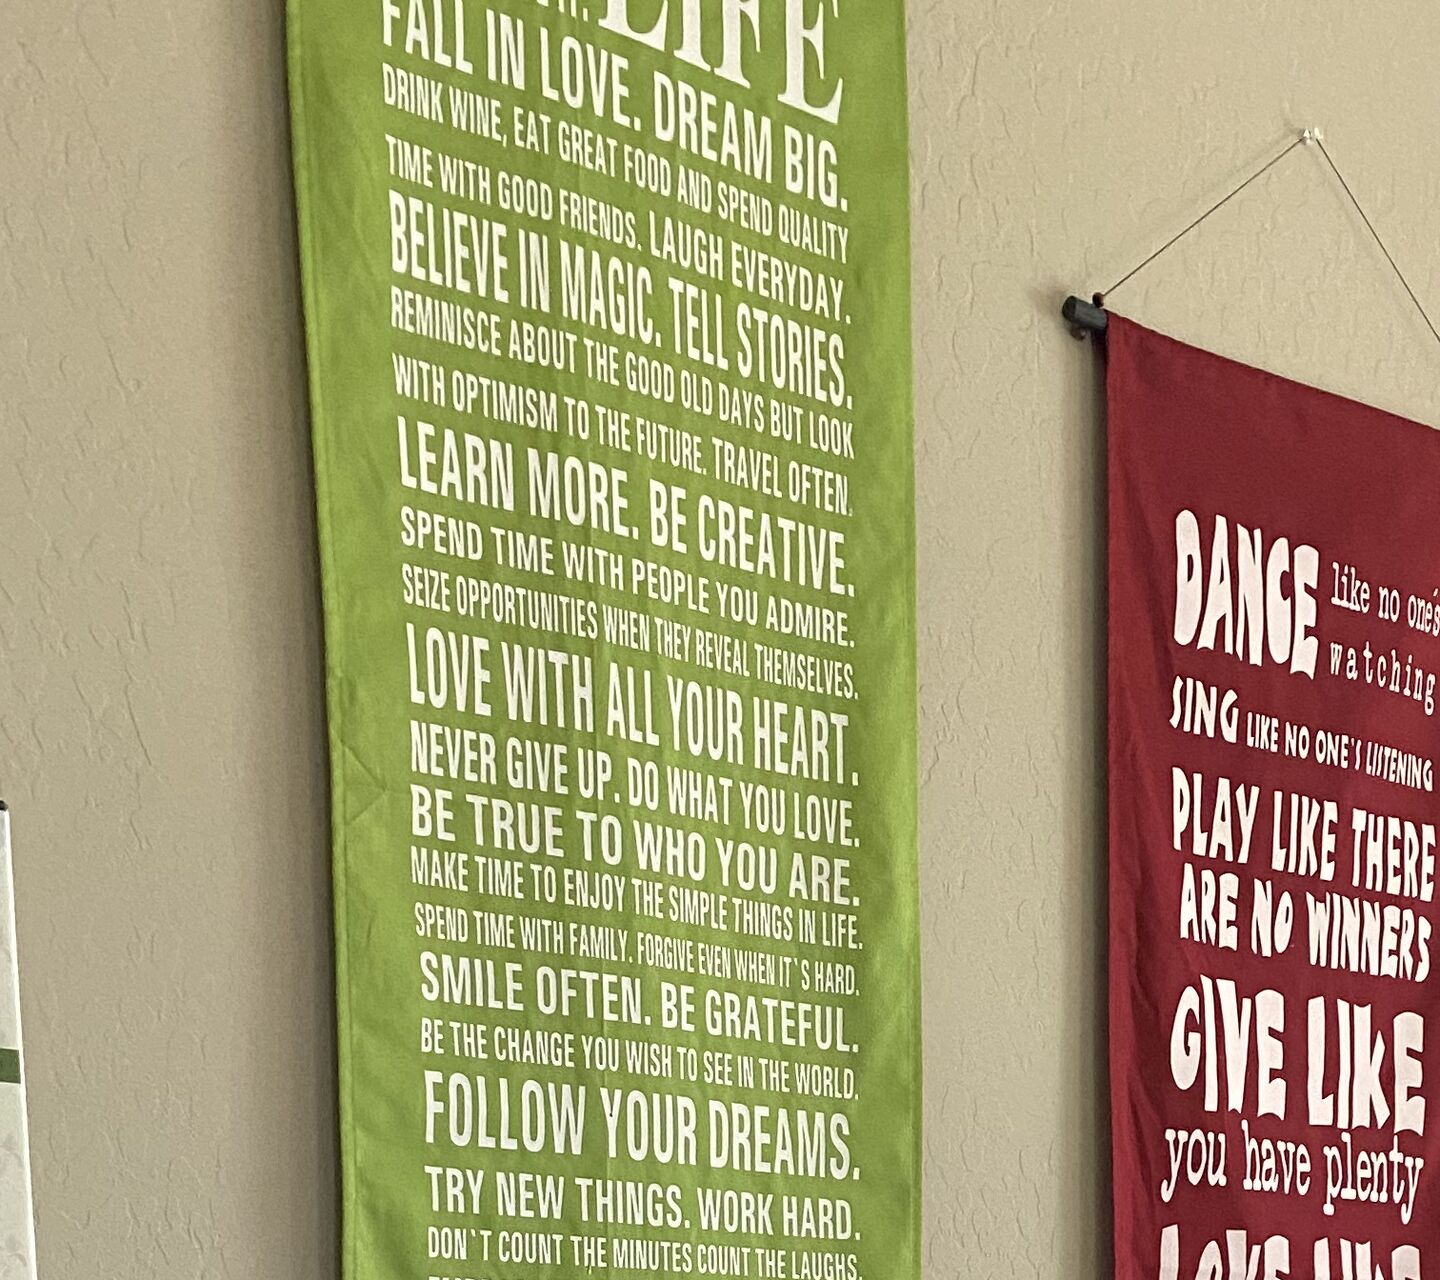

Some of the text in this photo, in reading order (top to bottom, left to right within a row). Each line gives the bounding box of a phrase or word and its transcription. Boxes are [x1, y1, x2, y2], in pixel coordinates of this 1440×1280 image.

[383, 0, 847, 211] FALL IN LOVE. DREAM BIG.
[383, 63, 848, 263] DRINK WINE, EAT GREAT FOOD AND SPEND QUALITY
[389, 190, 851, 409] BELIEVE IN MAGIC. TELL STORIES.
[398, 416, 854, 596] LEARN MORE. BE CREATIVE.
[402, 564, 858, 698] SEIZE OPPORTUNITIES WHEN THEY REVEAL THEMSELVES.
[1174, 510, 1319, 679] DANCE
[1331, 562, 1370, 613] like
[1378, 587, 1400, 622] no
[407, 623, 858, 785] LOVE WITH ALL YOUR HEART.
[1170, 676, 1239, 744] SING
[1246, 711, 1280, 753] LIKE
[1285, 721, 1310, 760] NO
[1366, 741, 1433, 792] LISTENING
[1330, 641, 1435, 715] watching
[411, 784, 859, 906] BE TRUE TO WHO YOU ARE.
[1173, 767, 1435, 902] PLAY LIKE THERE
[1180, 863, 1431, 982] ARE NO WINNERS
[420, 952, 858, 1052] SMILE OFTEN. BE GRATEFUL.
[1171, 975, 1286, 1120] GIVE
[425, 1071, 859, 1179] FOLLOW YOUR DREAMS.
[1161, 1120, 1424, 1224] you have plenty
[425, 1166, 860, 1240] TRY NEW THINGS. WORK HARD.
